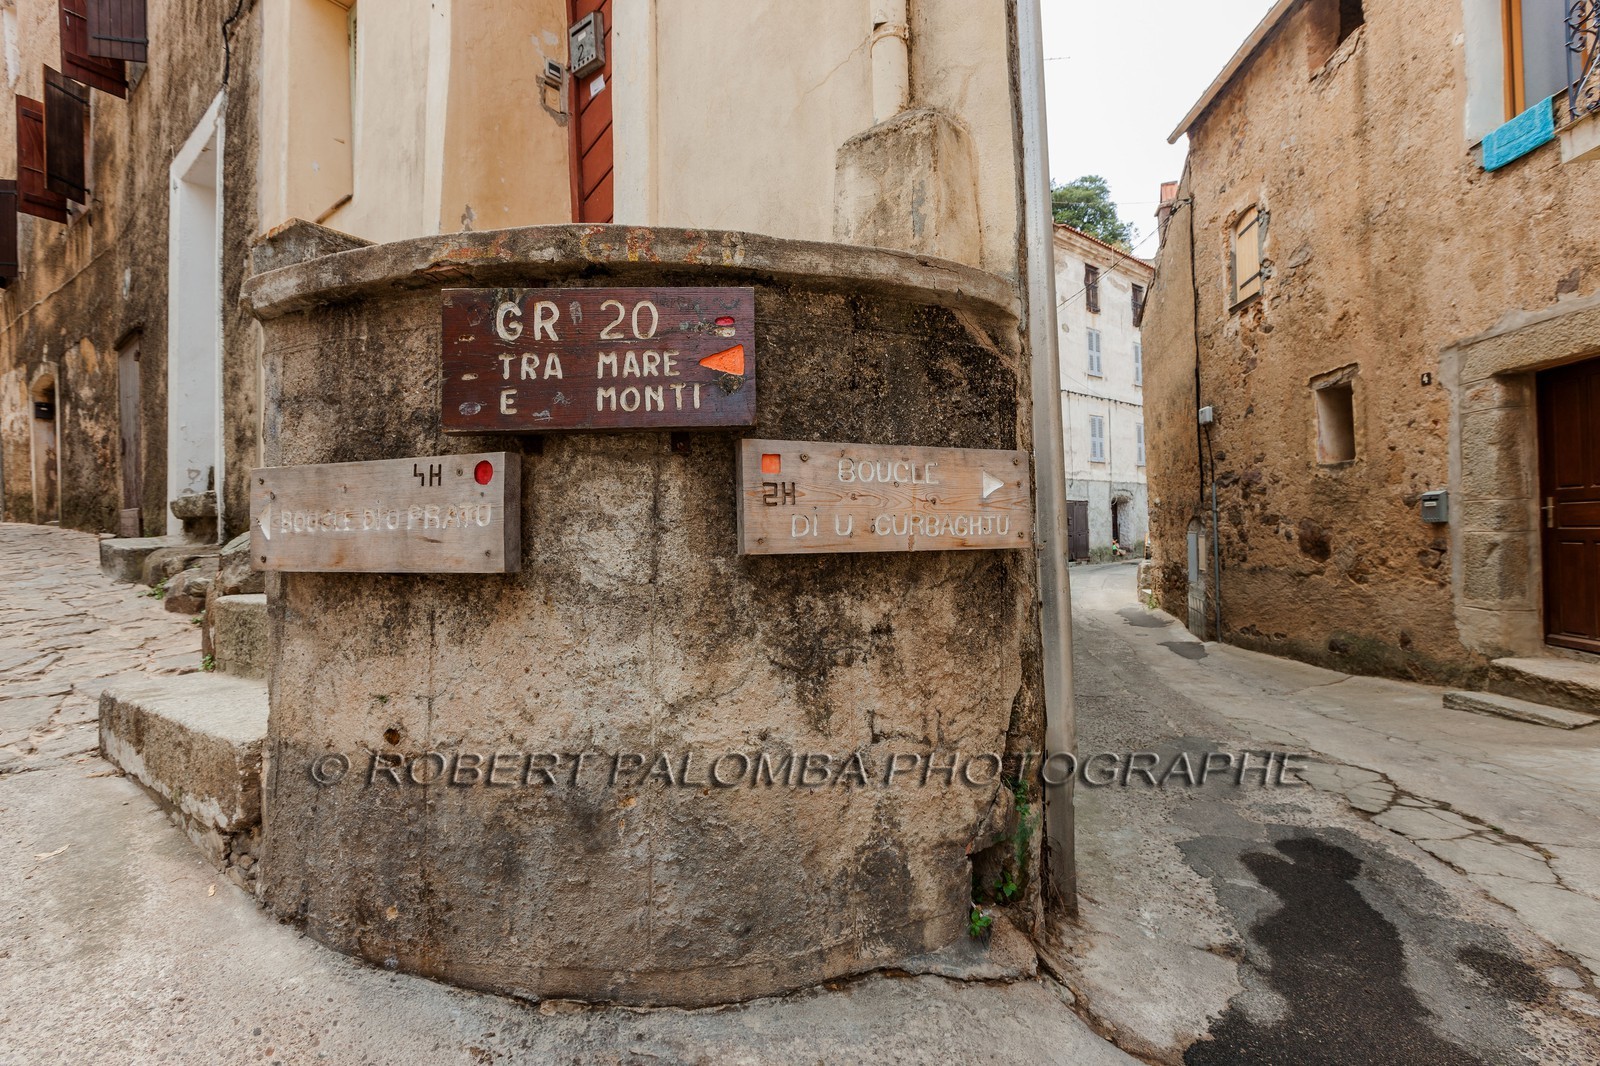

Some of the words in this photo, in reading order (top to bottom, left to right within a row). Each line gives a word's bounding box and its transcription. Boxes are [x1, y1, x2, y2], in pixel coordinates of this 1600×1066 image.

[577, 44, 585, 62] 2
[496, 300, 560, 342] GR
[600, 300, 659, 340] 20
[498, 352, 563, 380] TRA
[597, 350, 681, 380] MARE
[500, 388, 517, 415] E
[597, 382, 700, 412] MONTI
[413, 463, 442, 487] 4H
[838, 457, 939, 485] BOUCLE
[762, 481, 796, 506] 2H
[407, 502, 492, 530] PRATU
[834, 512, 853, 536] U
